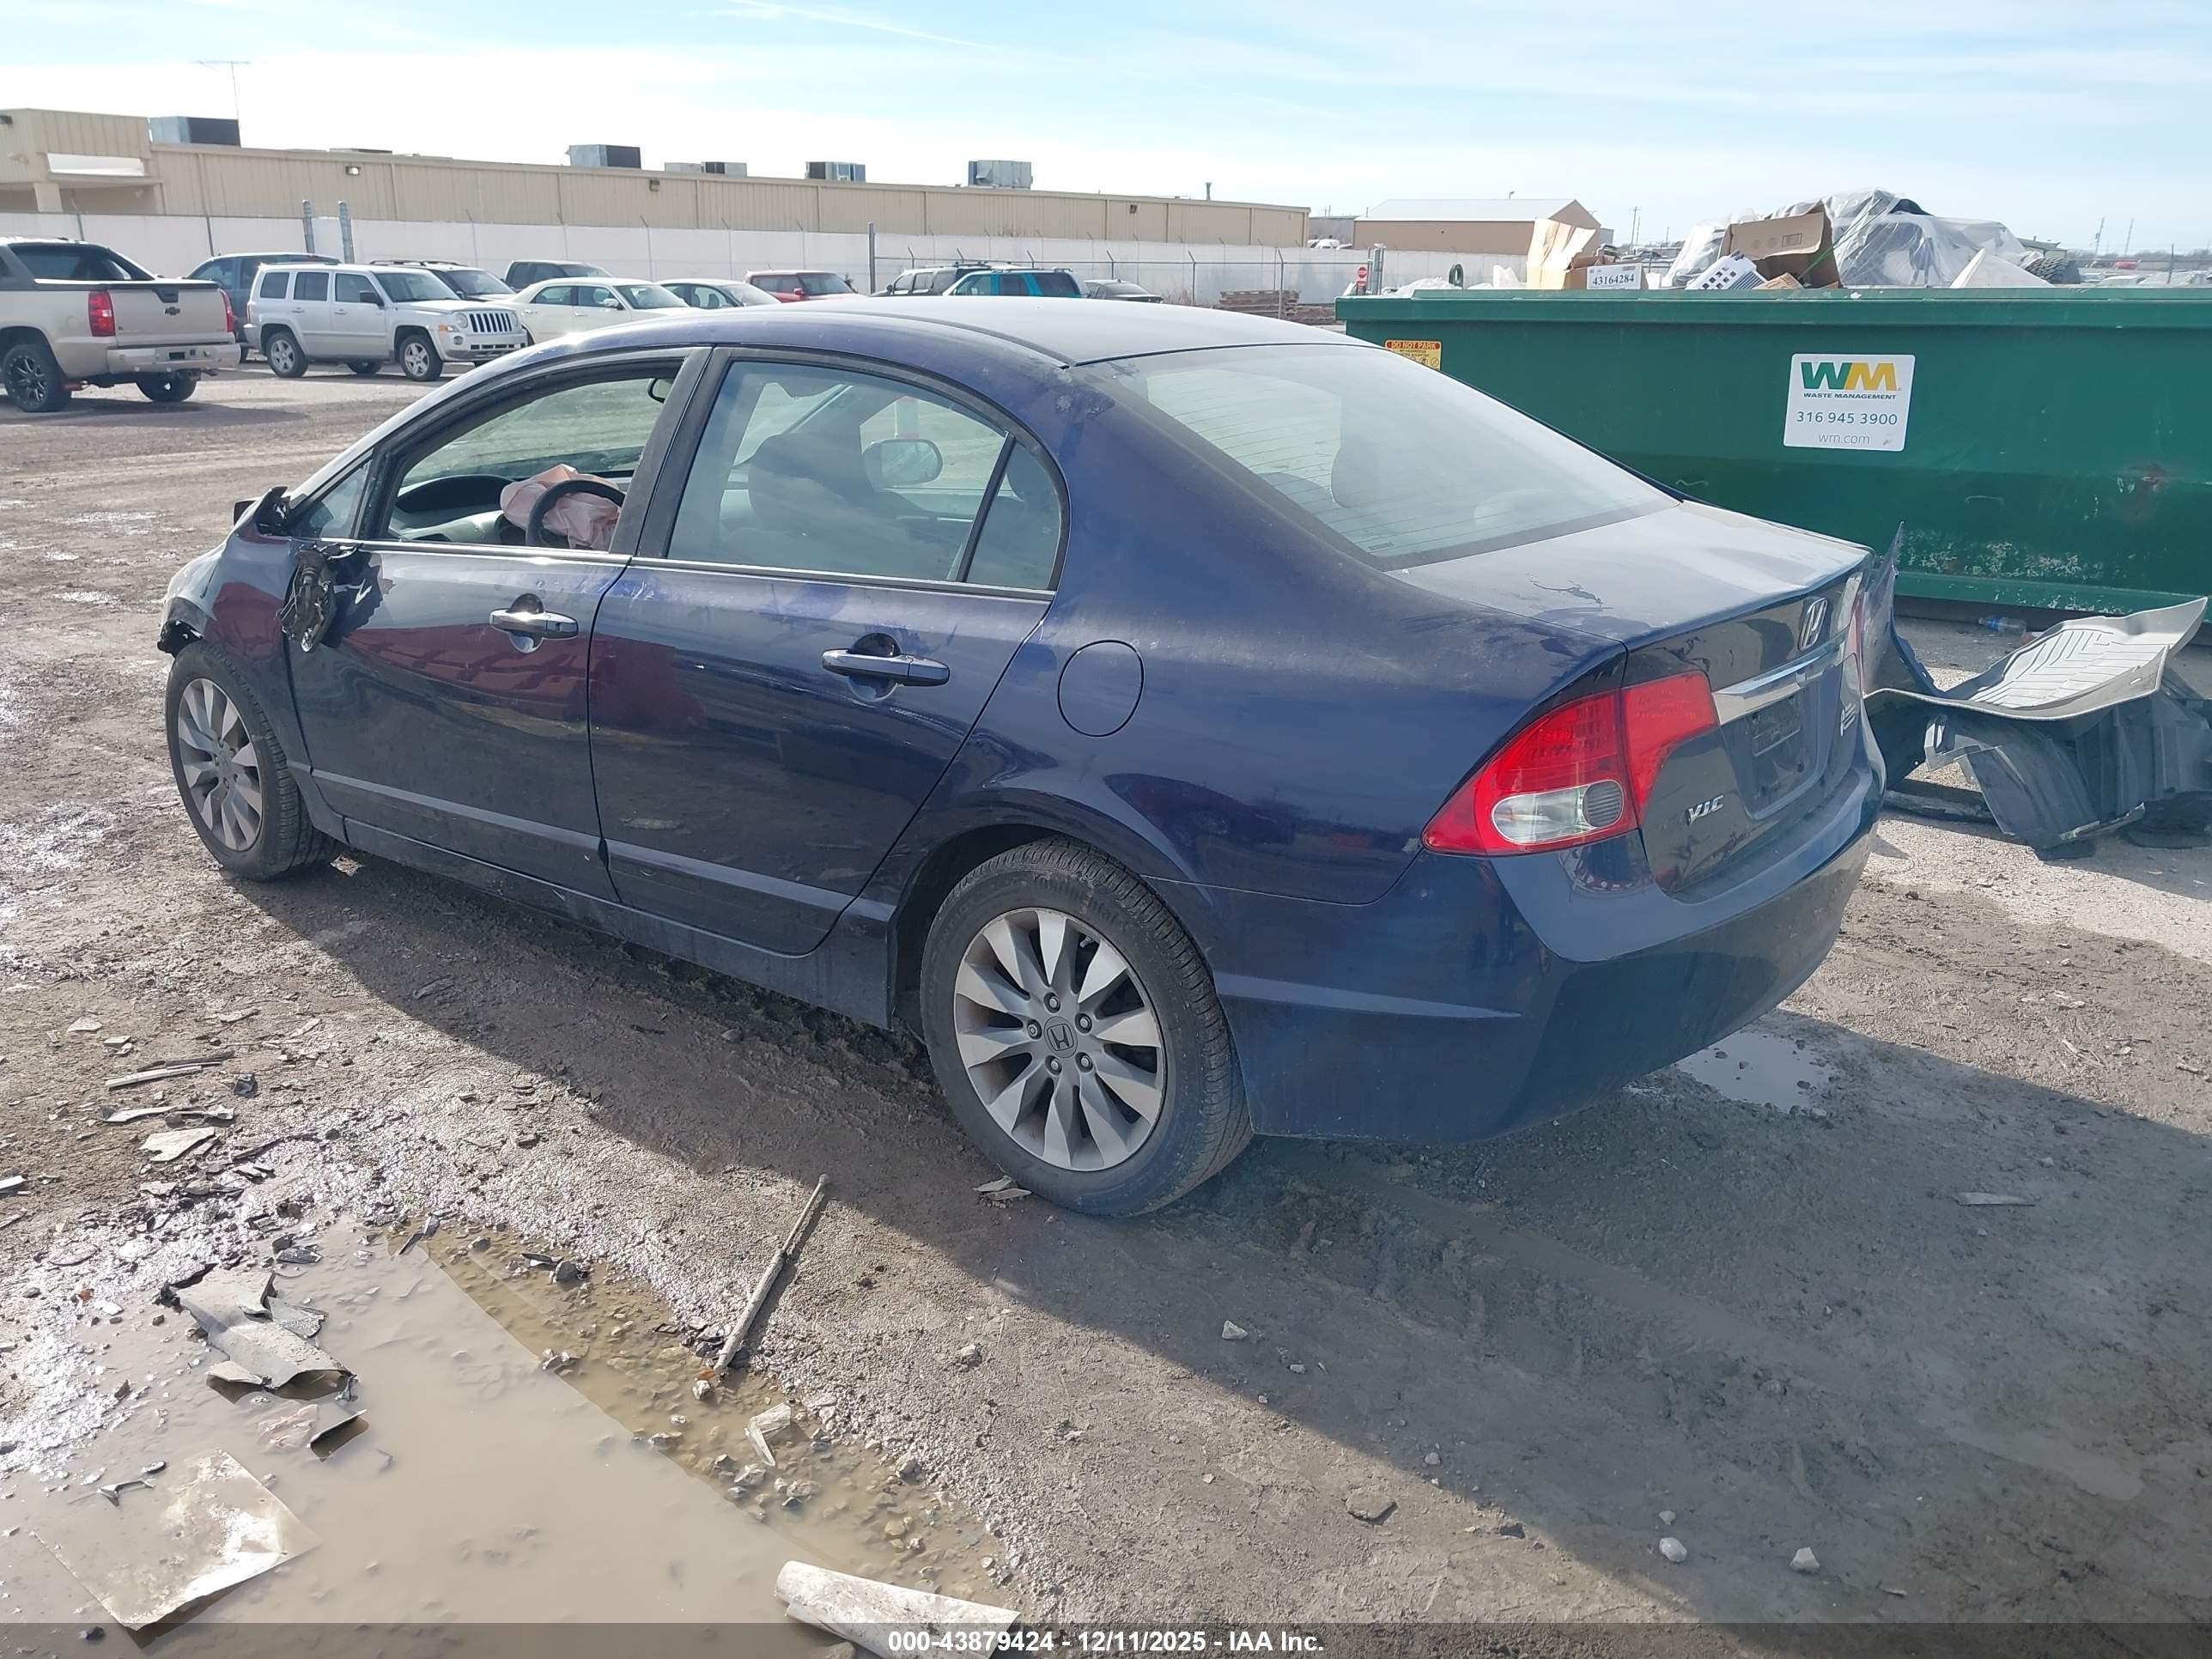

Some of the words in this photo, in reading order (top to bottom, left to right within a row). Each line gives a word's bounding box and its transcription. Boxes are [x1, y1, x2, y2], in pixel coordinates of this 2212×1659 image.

[1593, 274, 1634, 285] 43164284
[1800, 362, 1897, 391] WM
[1796, 410, 1823, 422] 316
[1827, 412, 1855, 424] 945
[1859, 413, 1898, 425] 3900
[1818, 434, 1870, 445] wm.com
